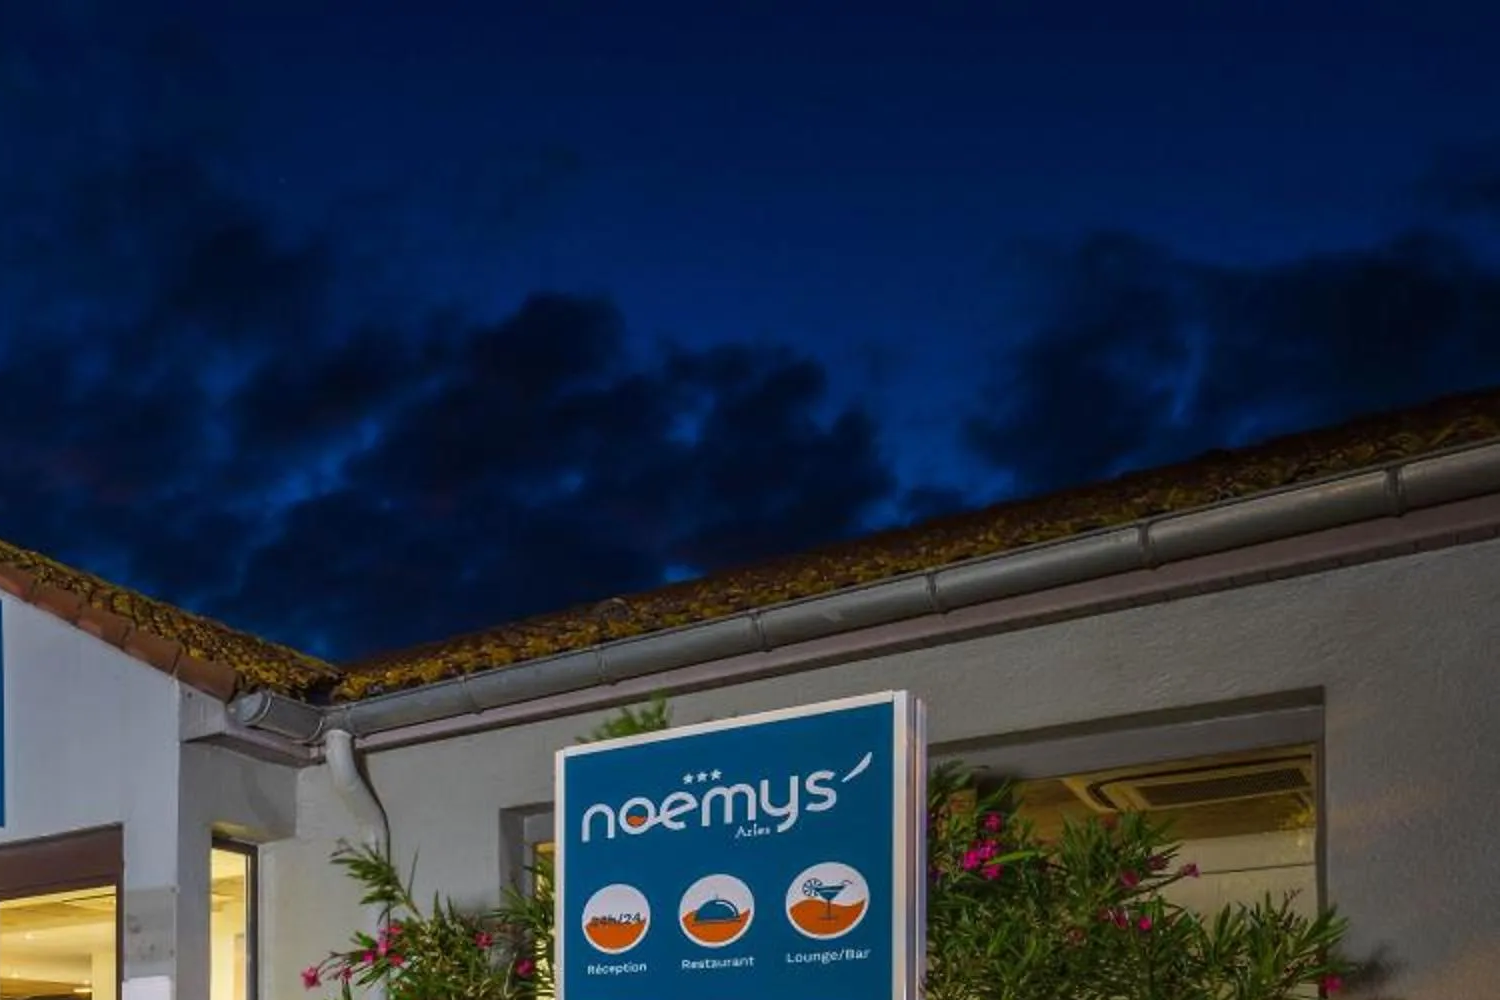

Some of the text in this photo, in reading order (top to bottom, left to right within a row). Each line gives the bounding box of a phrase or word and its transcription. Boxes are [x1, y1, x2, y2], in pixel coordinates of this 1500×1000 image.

[681, 956, 755, 970] Restaurant
[786, 949, 871, 965] Lounge/Bar
[587, 962, 647, 975] Réception
